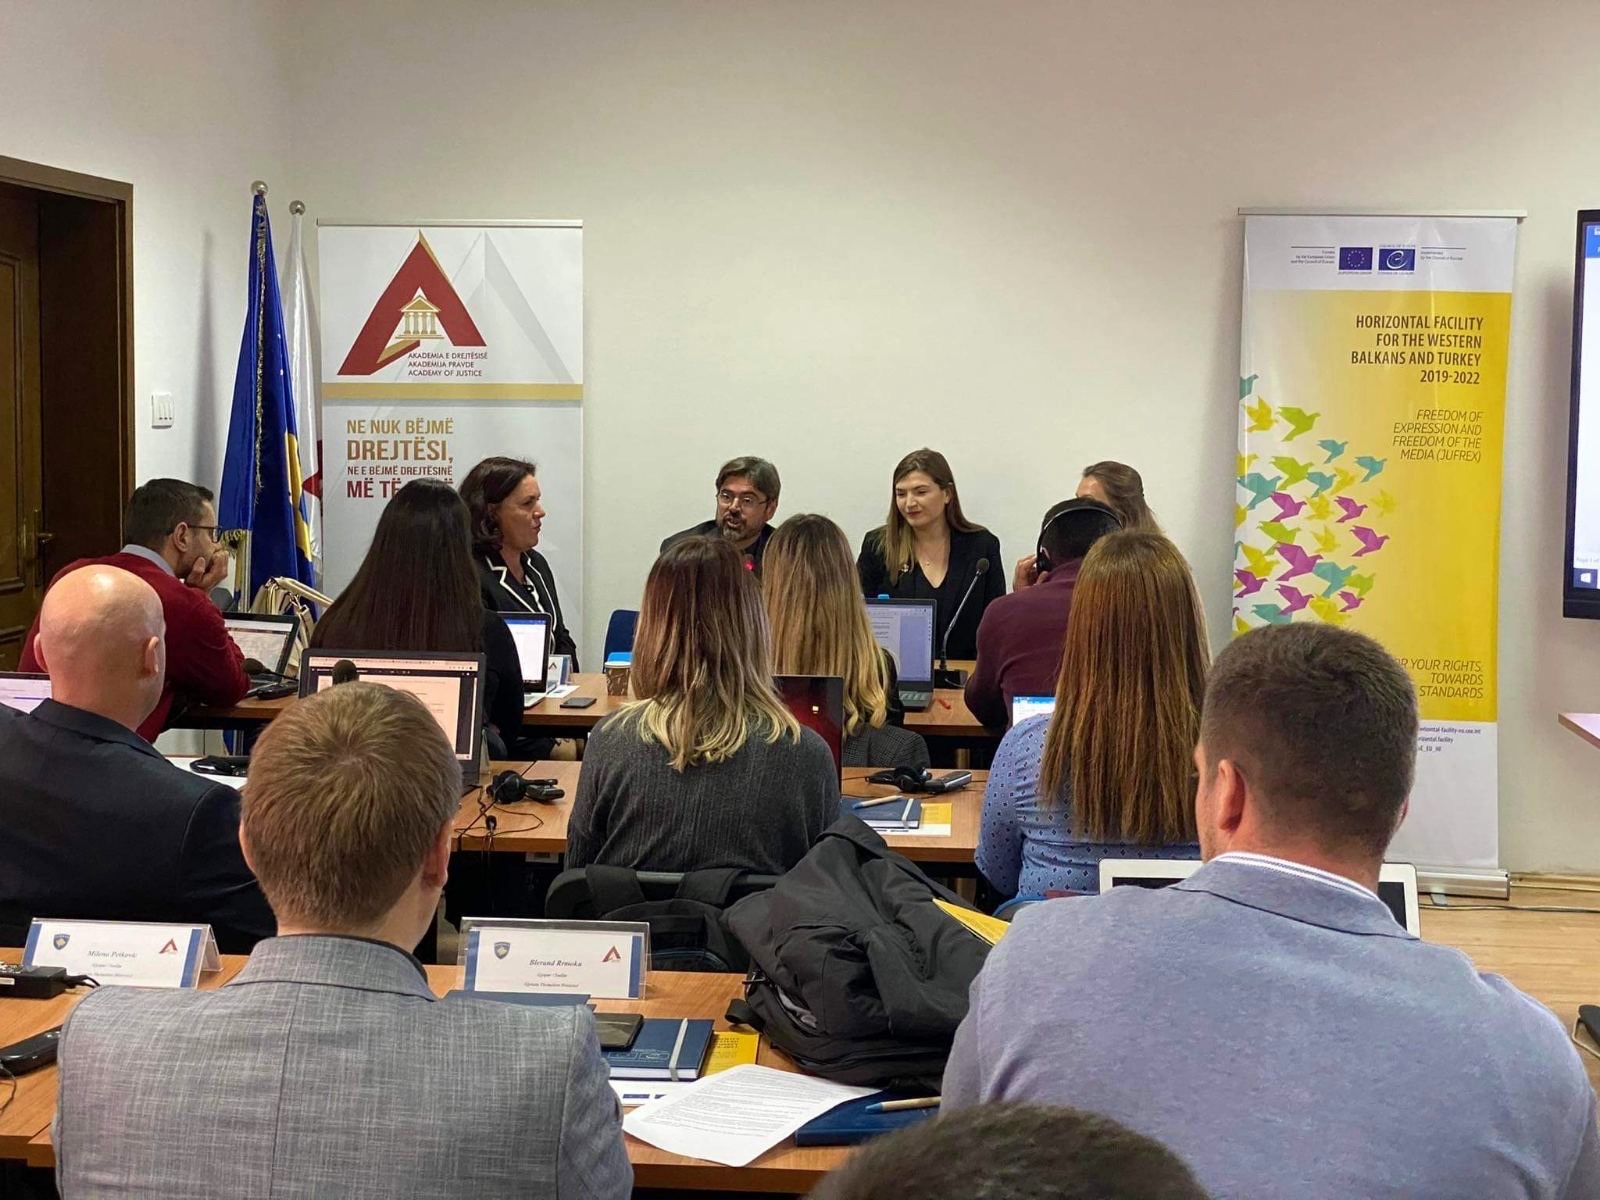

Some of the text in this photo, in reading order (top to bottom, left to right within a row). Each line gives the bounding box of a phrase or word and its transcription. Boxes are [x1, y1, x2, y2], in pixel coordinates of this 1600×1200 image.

[1356, 315, 1484, 330] HORIZONTAL FACILITY
[1376, 333, 1482, 349] FOR THE WESTERN
[1351, 351, 1481, 367] BALKANS AND TURKEY
[1420, 370, 1480, 385] 2019-2022
[1416, 409, 1484, 422] FREEDOM OF
[347, 417, 454, 434] NE NUK BËJMË
[1393, 422, 1482, 436] EXPRESSION AND
[1392, 435, 1482, 449] FREEDOM OF THE
[347, 436, 454, 464] DREJTËSI,
[1400, 449, 1482, 463] MEDIA (JUFREX)
[347, 465, 453, 476] NE E BËJMË DREJTËSINË
[346, 477, 374, 498] MË
[1410, 658, 1441, 671] YOUR
[1443, 659, 1482, 673] RIGHTS
[1430, 672, 1484, 686] TOWARDS
[1419, 685, 1484, 699] STANDARDS
